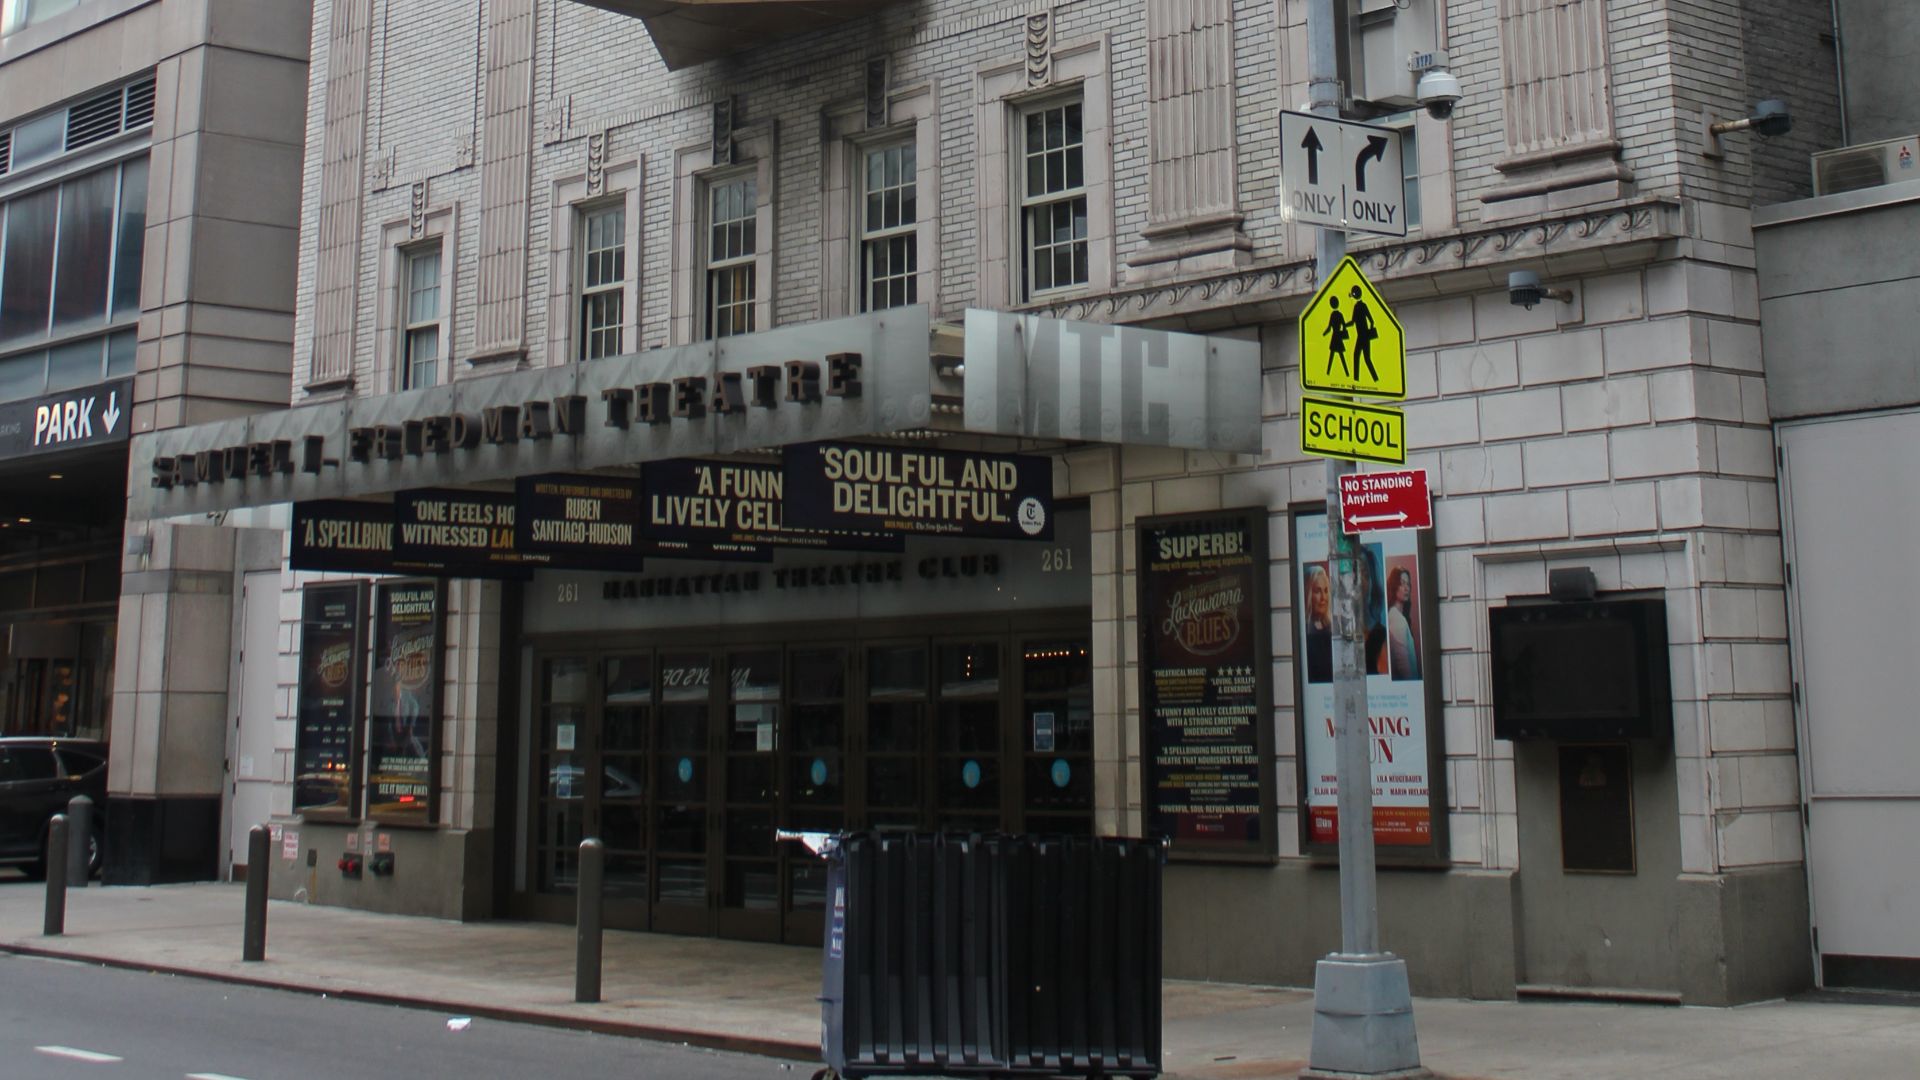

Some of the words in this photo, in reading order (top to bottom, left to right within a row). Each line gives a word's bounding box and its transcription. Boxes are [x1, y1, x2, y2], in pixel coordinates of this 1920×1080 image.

[1293, 190, 1336, 215] ONLY
[1353, 199, 1396, 224] ONLY
[34, 396, 96, 446] PARK
[151, 440, 294, 488] SAMUEL
[350, 395, 587, 463] FRIEDMAN
[601, 352, 863, 430] THEATRE
[1309, 411, 1398, 448] SCHOOL
[960, 457, 1017, 491] AND
[1345, 480, 1359, 492] NO
[1362, 476, 1413, 491] STANDING
[565, 497, 601, 521] RUBEN
[652, 494, 731, 528] LIVELY
[1347, 492, 1389, 507] Anytime
[450, 503, 493, 525] FEELS
[402, 523, 487, 548] WITNESSED
[532, 519, 633, 546] SANTIAGO-HUDSON
[1043, 547, 1074, 573] 261
[774, 560, 901, 588] THEATRE
[557, 584, 579, 602] 261
[1187, 615, 1231, 647] BLUES
